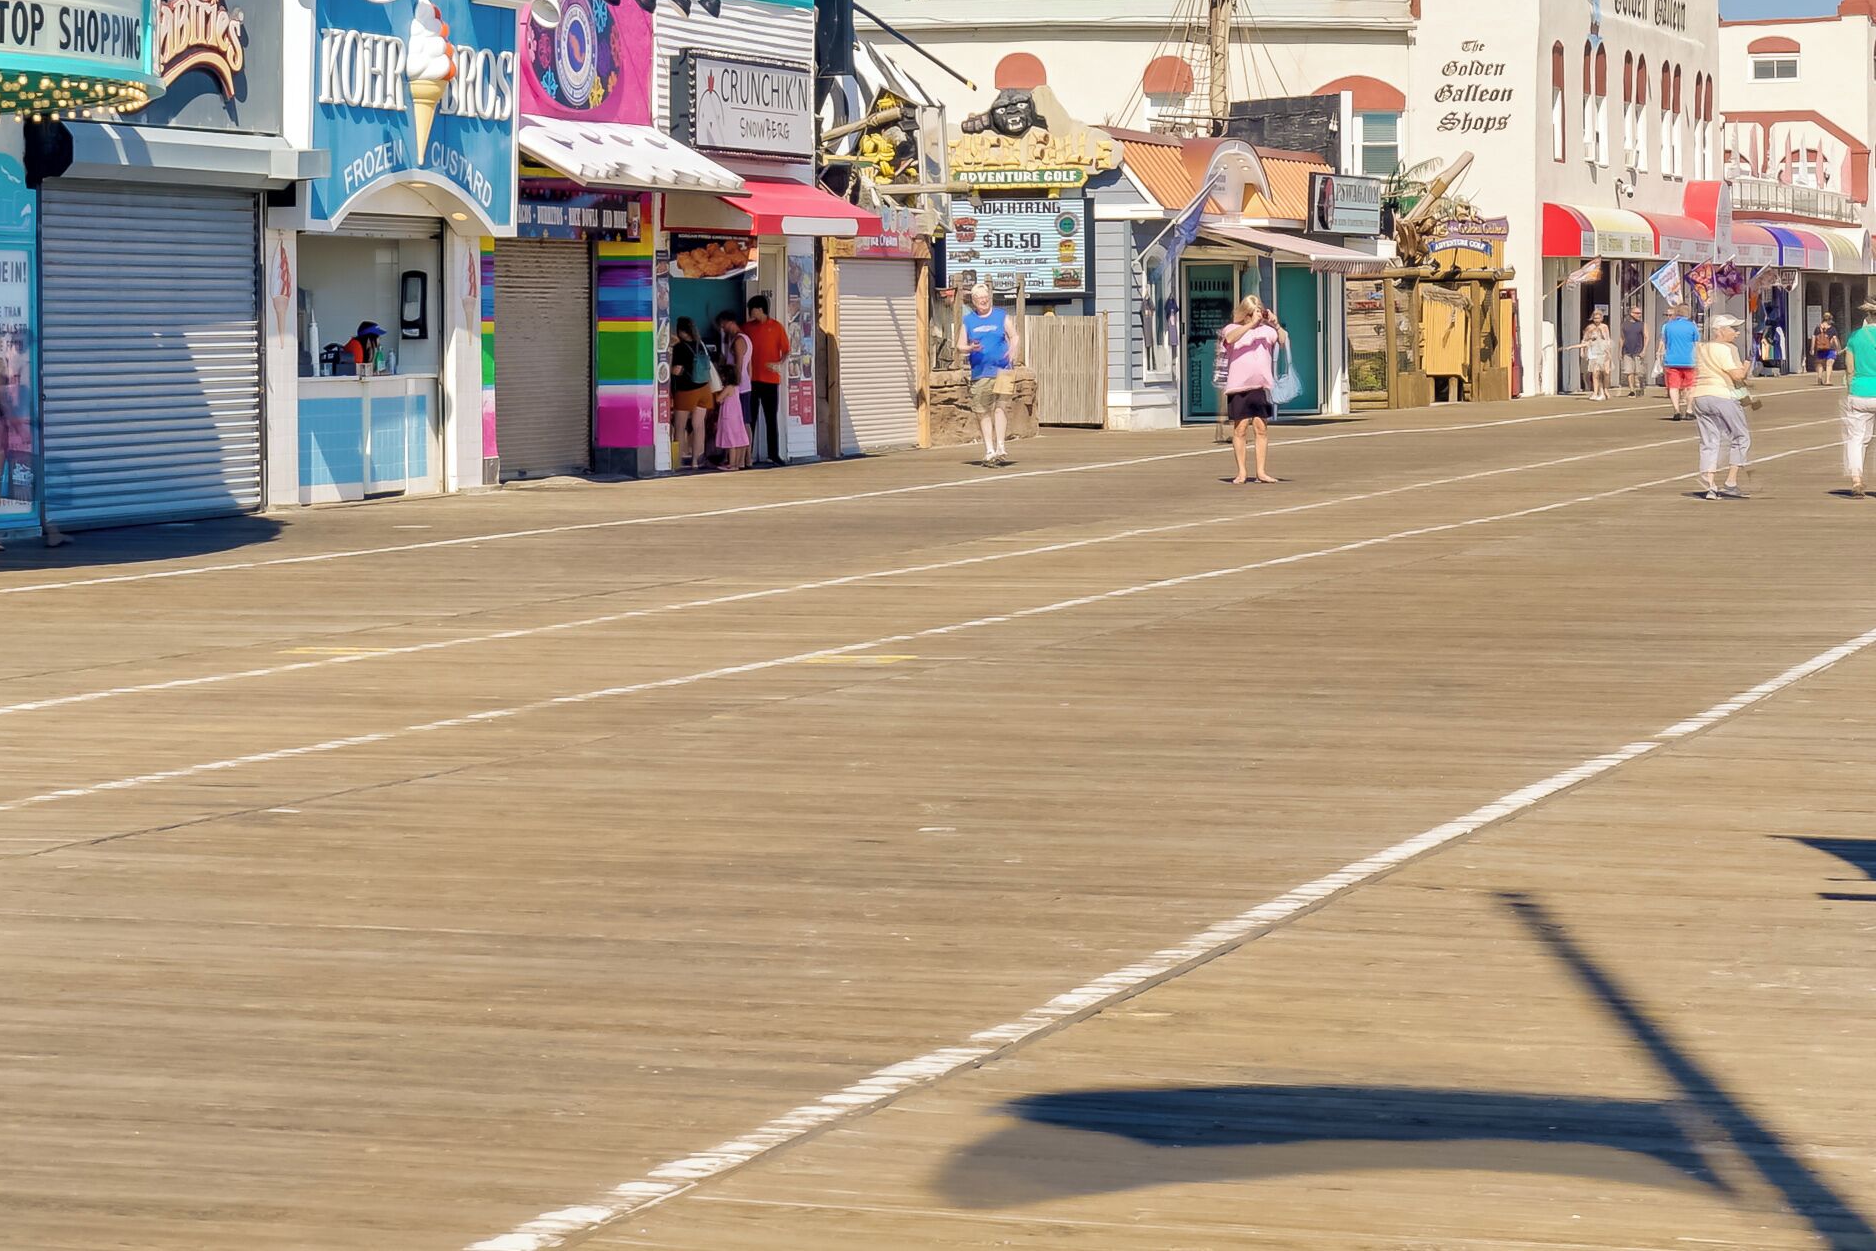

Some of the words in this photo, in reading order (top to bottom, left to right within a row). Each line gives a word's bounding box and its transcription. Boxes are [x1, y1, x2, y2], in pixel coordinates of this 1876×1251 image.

[59, 6, 142, 61] SHOPPING
[1461, 40, 1485, 53] The
[319, 28, 408, 111] KOHR
[1441, 60, 1506, 77] Golden
[721, 68, 807, 112] CRUNCHIK'N
[1434, 84, 1513, 103] Galleon
[740, 117, 790, 142] SNOWBERG
[1437, 111, 1512, 135] Shops
[343, 139, 404, 195] FROZEN
[431, 141, 492, 209] CUSTARD
[959, 170, 1040, 183] ADVENTURE
[1043, 170, 1077, 182] GOLF
[974, 203, 1004, 214] NOW
[1007, 201, 1061, 214] HIRING
[983, 232, 1041, 249] $16.50
[1434, 239, 1468, 250] ADVENTURE
[1469, 240, 1487, 250] GOLF
[4, 306, 22, 318] THAN
